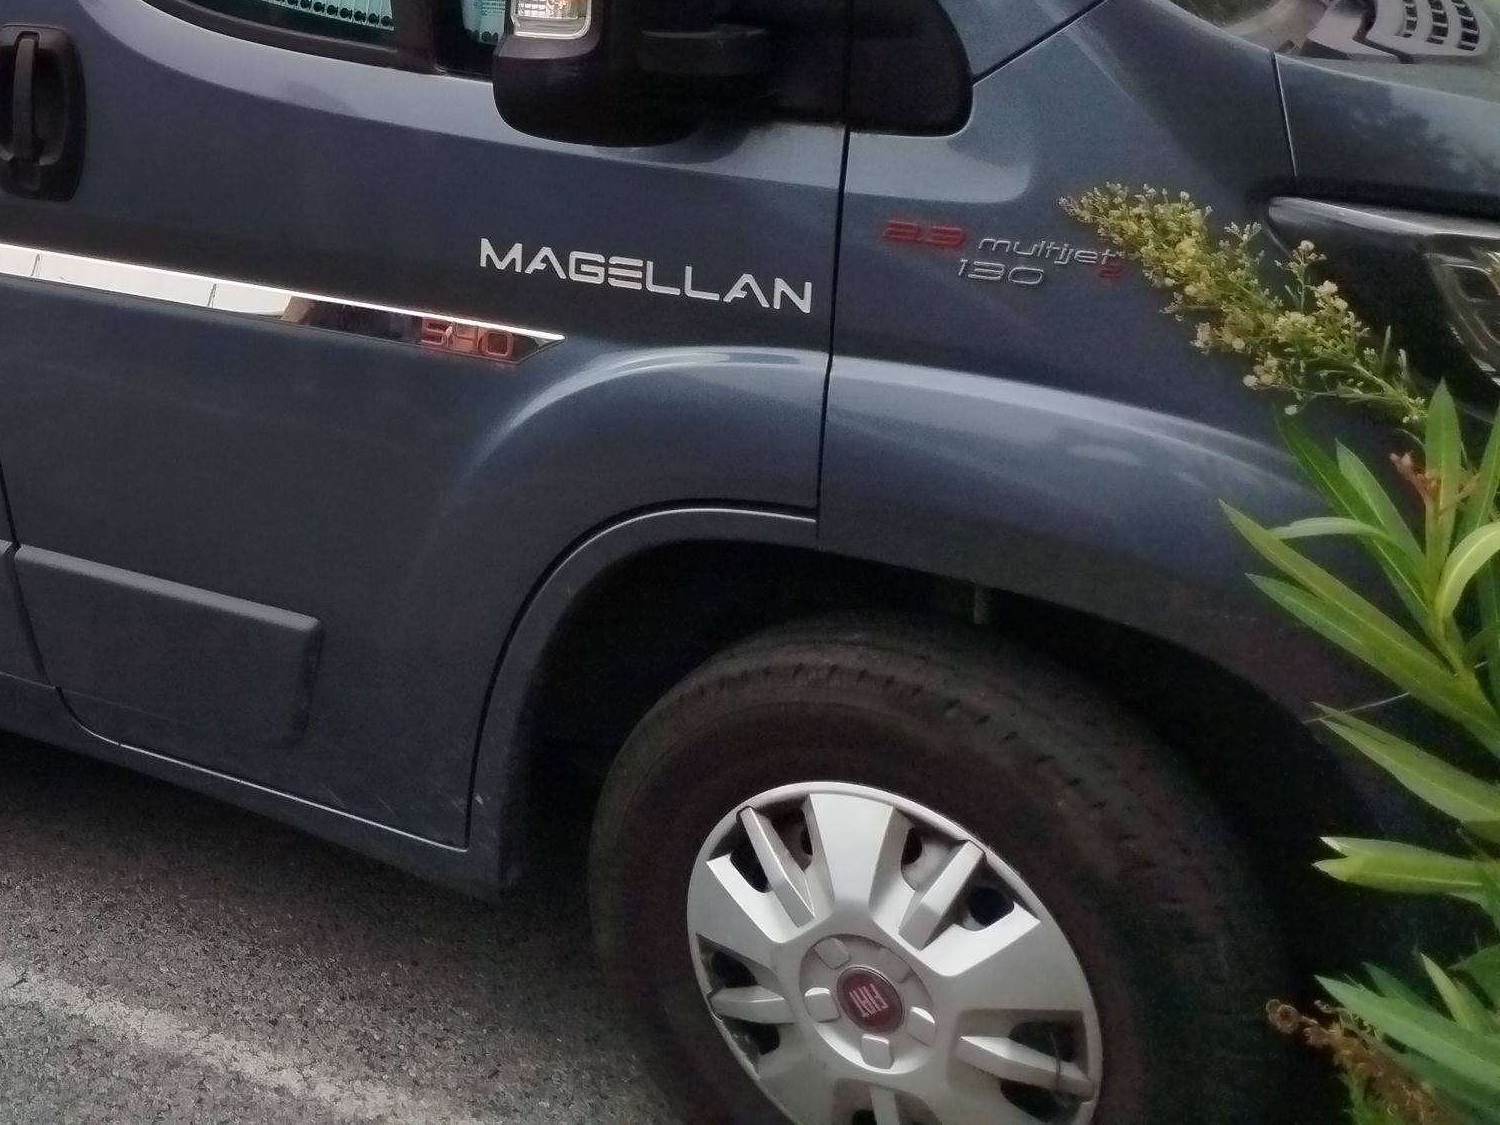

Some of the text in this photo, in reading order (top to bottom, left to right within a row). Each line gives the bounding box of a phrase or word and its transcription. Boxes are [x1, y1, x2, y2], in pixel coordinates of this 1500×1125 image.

[977, 237, 1117, 265] multijet
[478, 238, 812, 313] MAGELLAN
[957, 258, 1045, 285] 130
[420, 318, 514, 357] 540
[849, 983, 889, 1017] FIAT
